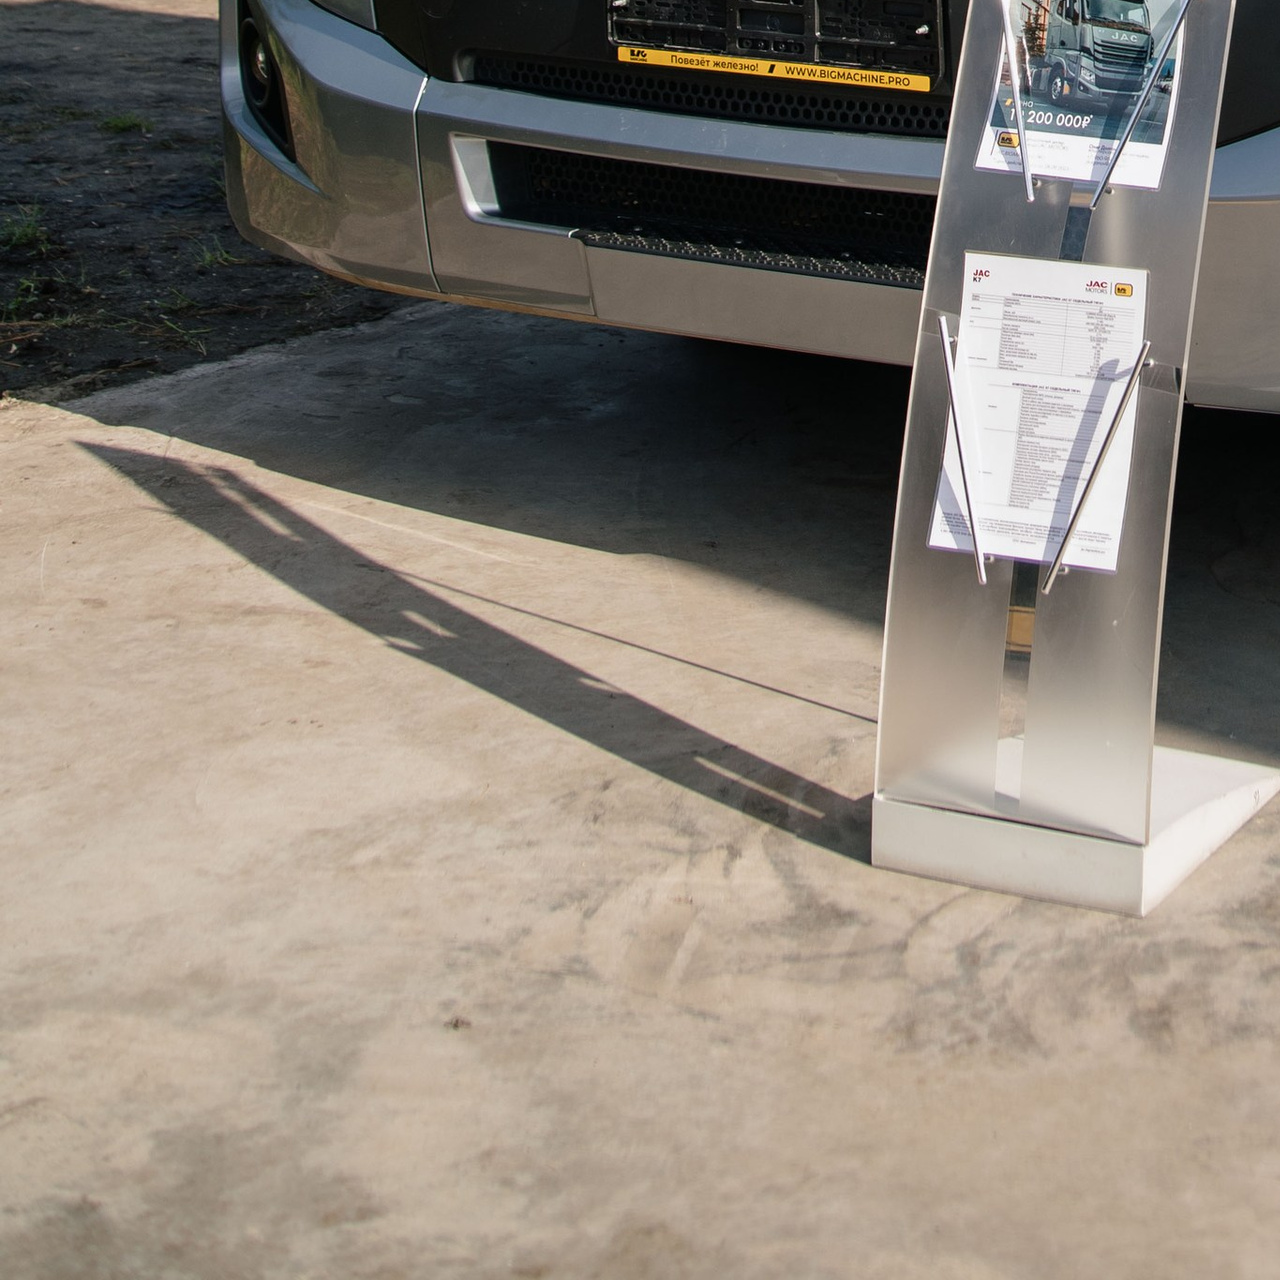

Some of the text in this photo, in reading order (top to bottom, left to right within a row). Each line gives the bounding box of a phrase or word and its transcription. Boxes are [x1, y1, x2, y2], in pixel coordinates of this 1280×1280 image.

[1111, 32, 1138, 42] JAC
[670, 54, 759, 72] Повезёт железно!
[785, 65, 911, 87] WWW.BIGMACHINE.PRO
[1027, 110, 1053, 125] 200
[972, 269, 991, 278] JAC
[1086, 280, 1108, 288] JAC
